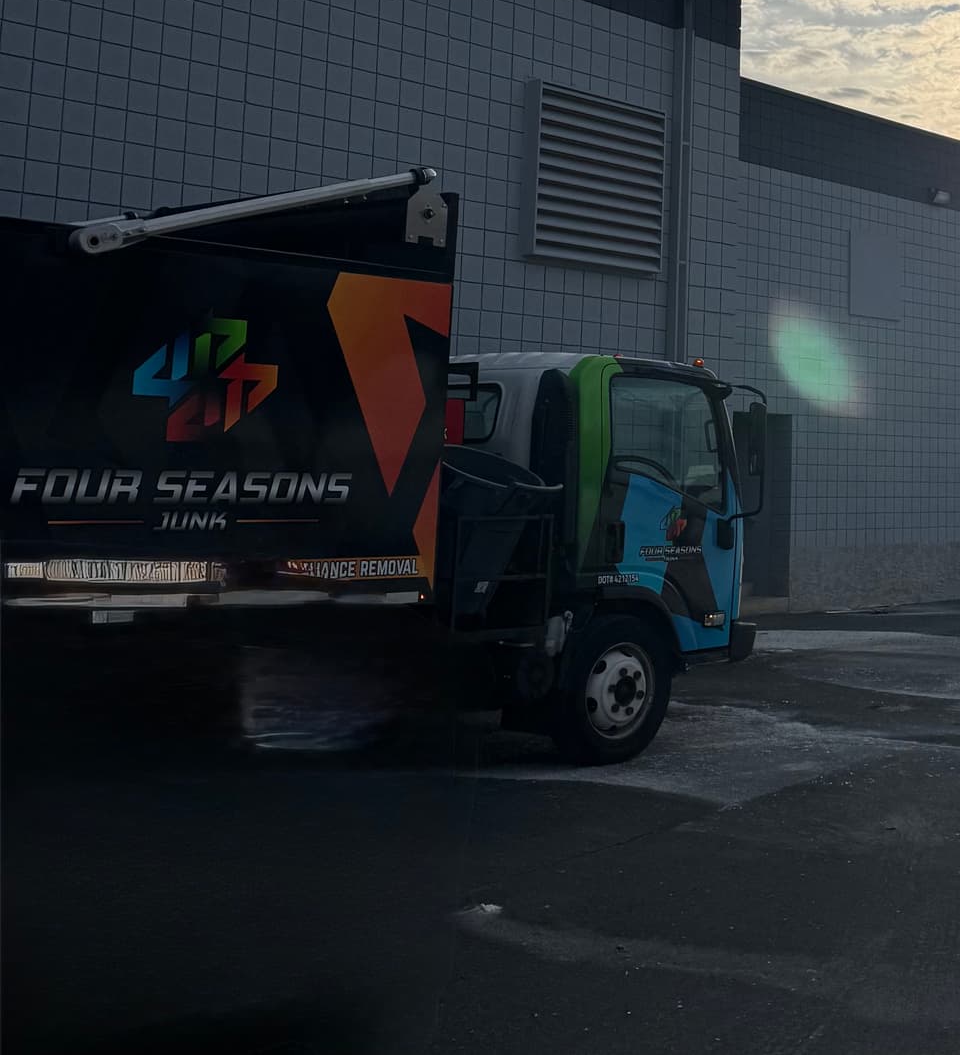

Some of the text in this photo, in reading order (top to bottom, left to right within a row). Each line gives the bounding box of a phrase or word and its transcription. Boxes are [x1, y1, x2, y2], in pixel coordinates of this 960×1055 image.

[10, 467, 353, 505] FOUR SEASONS
[152, 511, 229, 532] JUNK
[639, 545, 703, 556] FOUR SEASONS
[360, 557, 419, 577] REMOVAL
